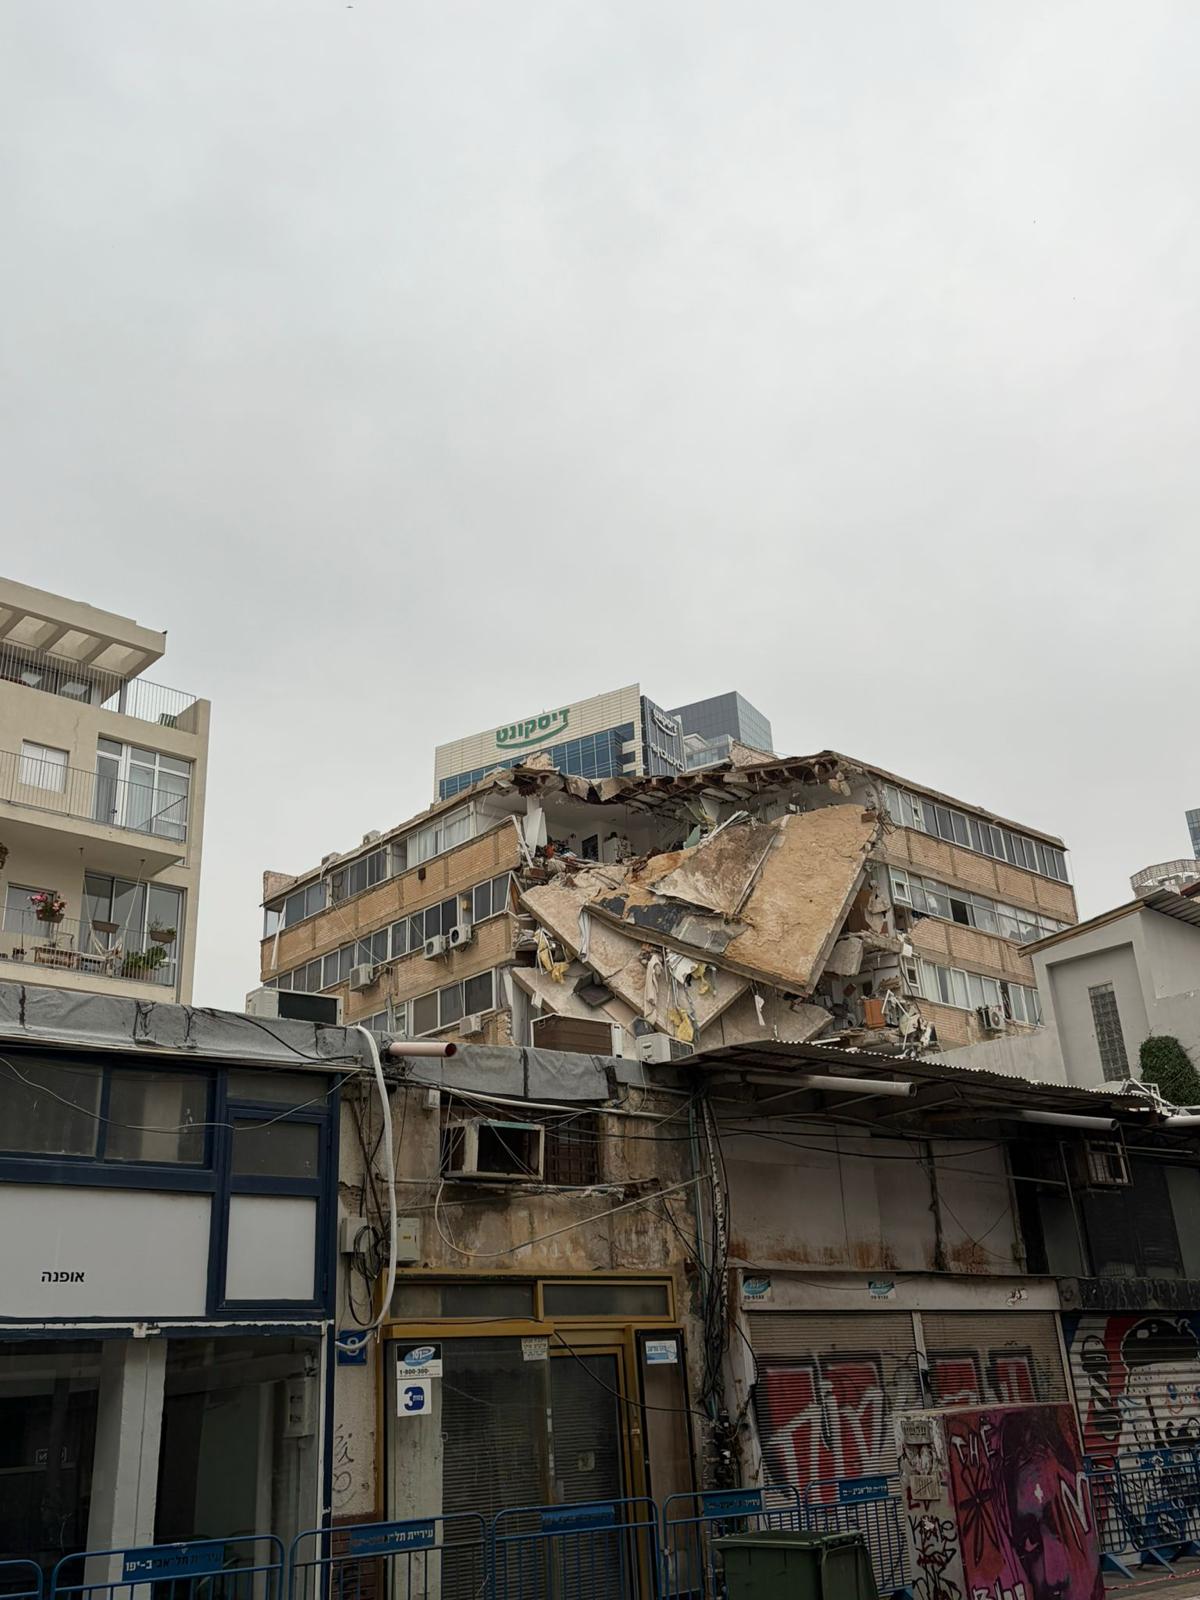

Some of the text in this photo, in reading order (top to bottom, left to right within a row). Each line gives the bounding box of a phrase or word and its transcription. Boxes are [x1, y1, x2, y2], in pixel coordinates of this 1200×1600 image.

[496, 708, 570, 741] דיסקונט
[41, 1270, 85, 1284] אופנה
[407, 1528, 434, 1541] עיריית
